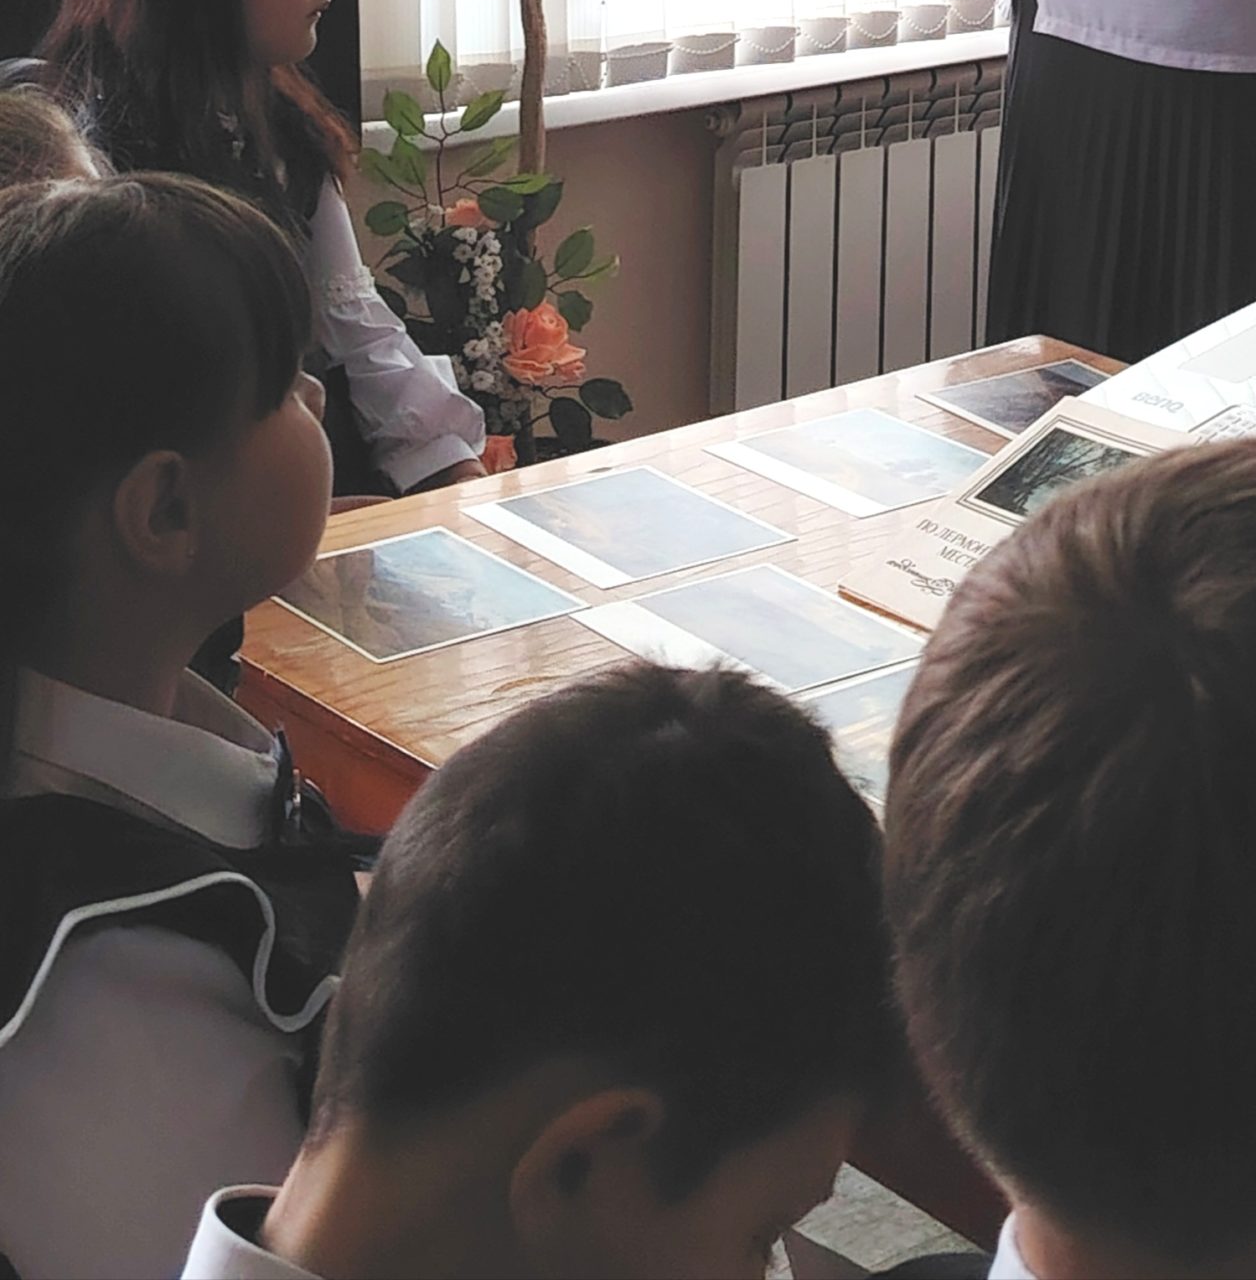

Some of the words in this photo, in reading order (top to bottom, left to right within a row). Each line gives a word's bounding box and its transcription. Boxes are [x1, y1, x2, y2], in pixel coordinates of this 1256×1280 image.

[1131, 391, 1185, 414] BenQ
[916, 519, 938, 534] ПО
[934, 527, 994, 556] ЛЕРМОН
[937, 545, 979, 570] МЕСТ
